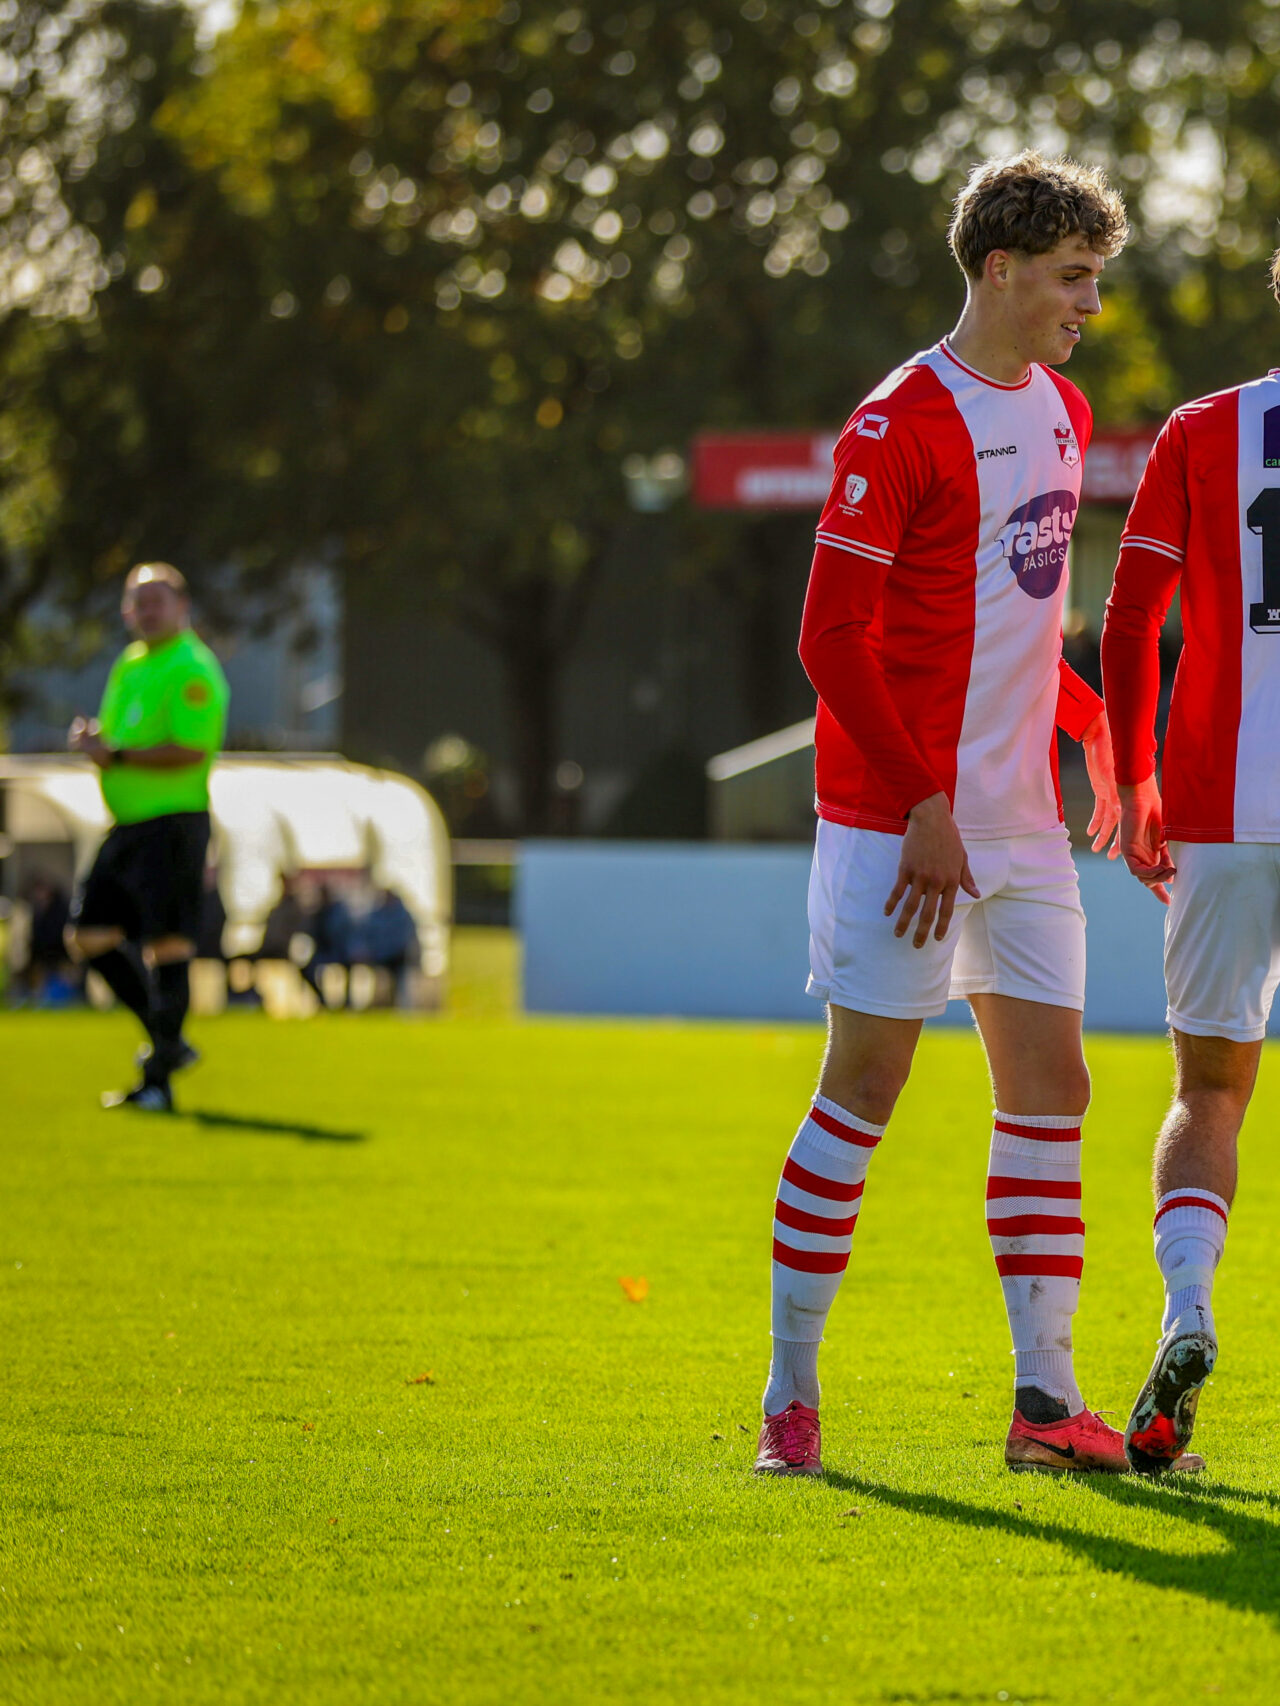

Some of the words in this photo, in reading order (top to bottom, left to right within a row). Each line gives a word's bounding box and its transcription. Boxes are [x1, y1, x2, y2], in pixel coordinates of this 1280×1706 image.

[977, 445, 1017, 460] STANNO
[994, 505, 1078, 557] Tasty
[1022, 547, 1066, 573] BASICS
